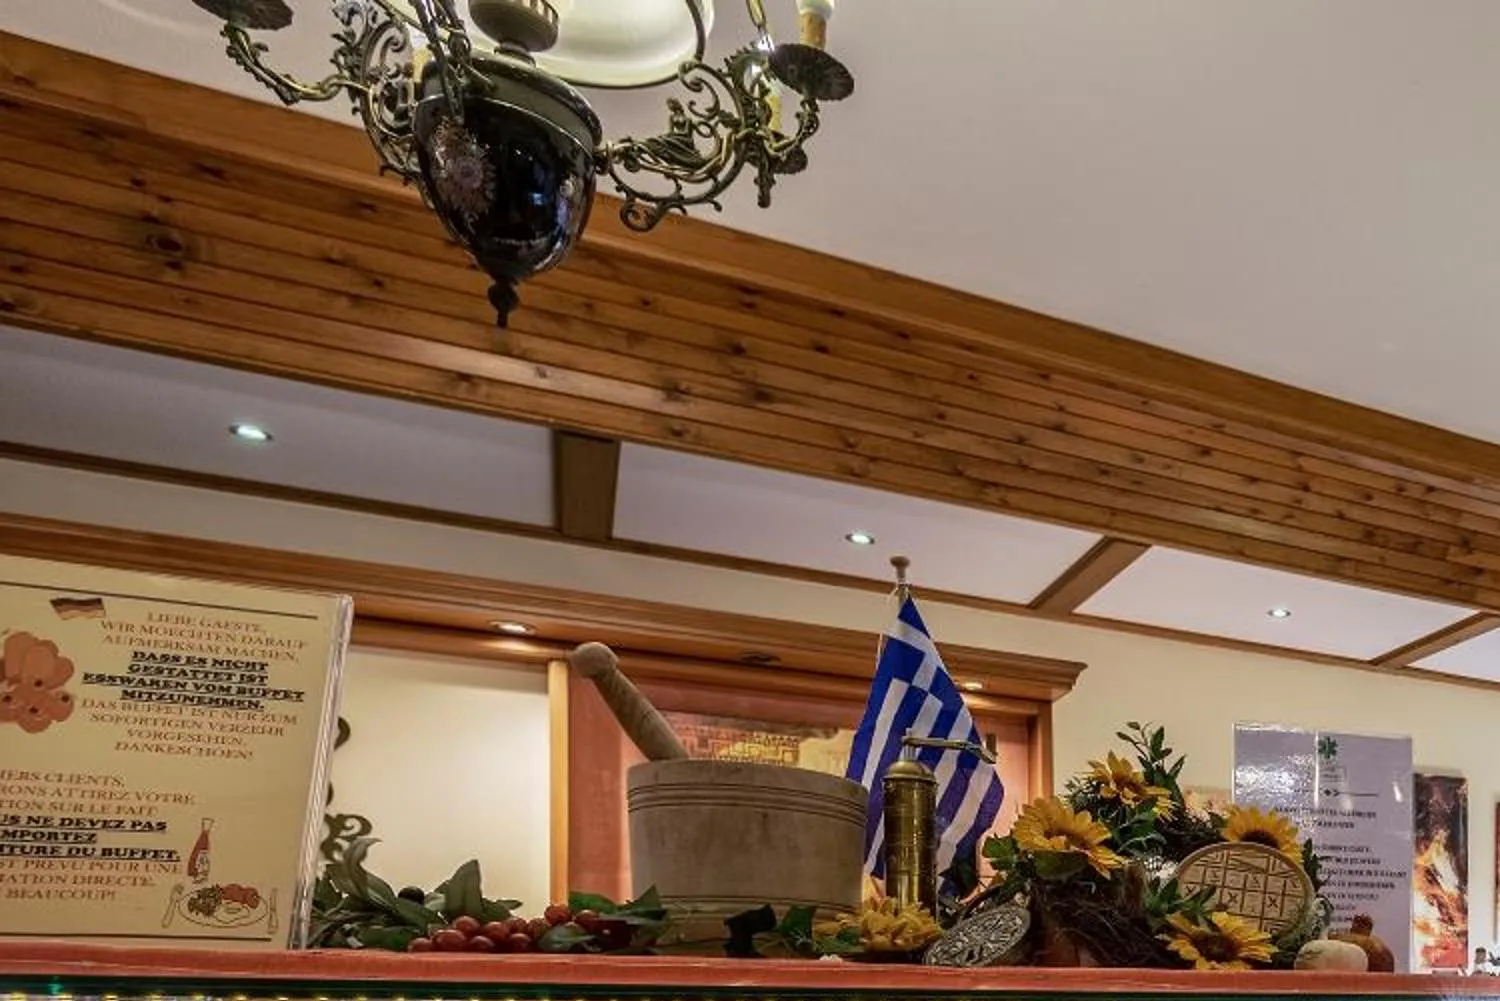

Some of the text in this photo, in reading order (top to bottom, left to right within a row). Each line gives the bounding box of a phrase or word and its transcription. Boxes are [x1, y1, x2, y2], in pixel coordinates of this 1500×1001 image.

[148, 611, 196, 624] LIEBE
[101, 620, 309, 651] WIR MOECHTEN DARAUF
[102, 635, 220, 655] AUFMERKSAM
[131, 650, 268, 672] DASS ES NICHT
[128, 663, 268, 686] GESTATTET IST
[82, 671, 304, 702] ESSWAREN VOM BUFFET
[120, 689, 265, 711] MITZUNEHMEN.
[81, 698, 298, 725] DAS BUFFET IST NUR ZUM
[90, 713, 285, 737] SOFORTIGEN VERZEHR
[49, 801, 85, 813] SUR
[89, 803, 113, 815] LE
[134, 790, 195, 805] VOTRE
[26, 815, 55, 827] NE
[59, 817, 126, 830] DEVEZ
[130, 820, 168, 832] PAS
[67, 845, 96, 857] DU
[88, 861, 141, 873] POUR
[145, 863, 184, 875] UNE
